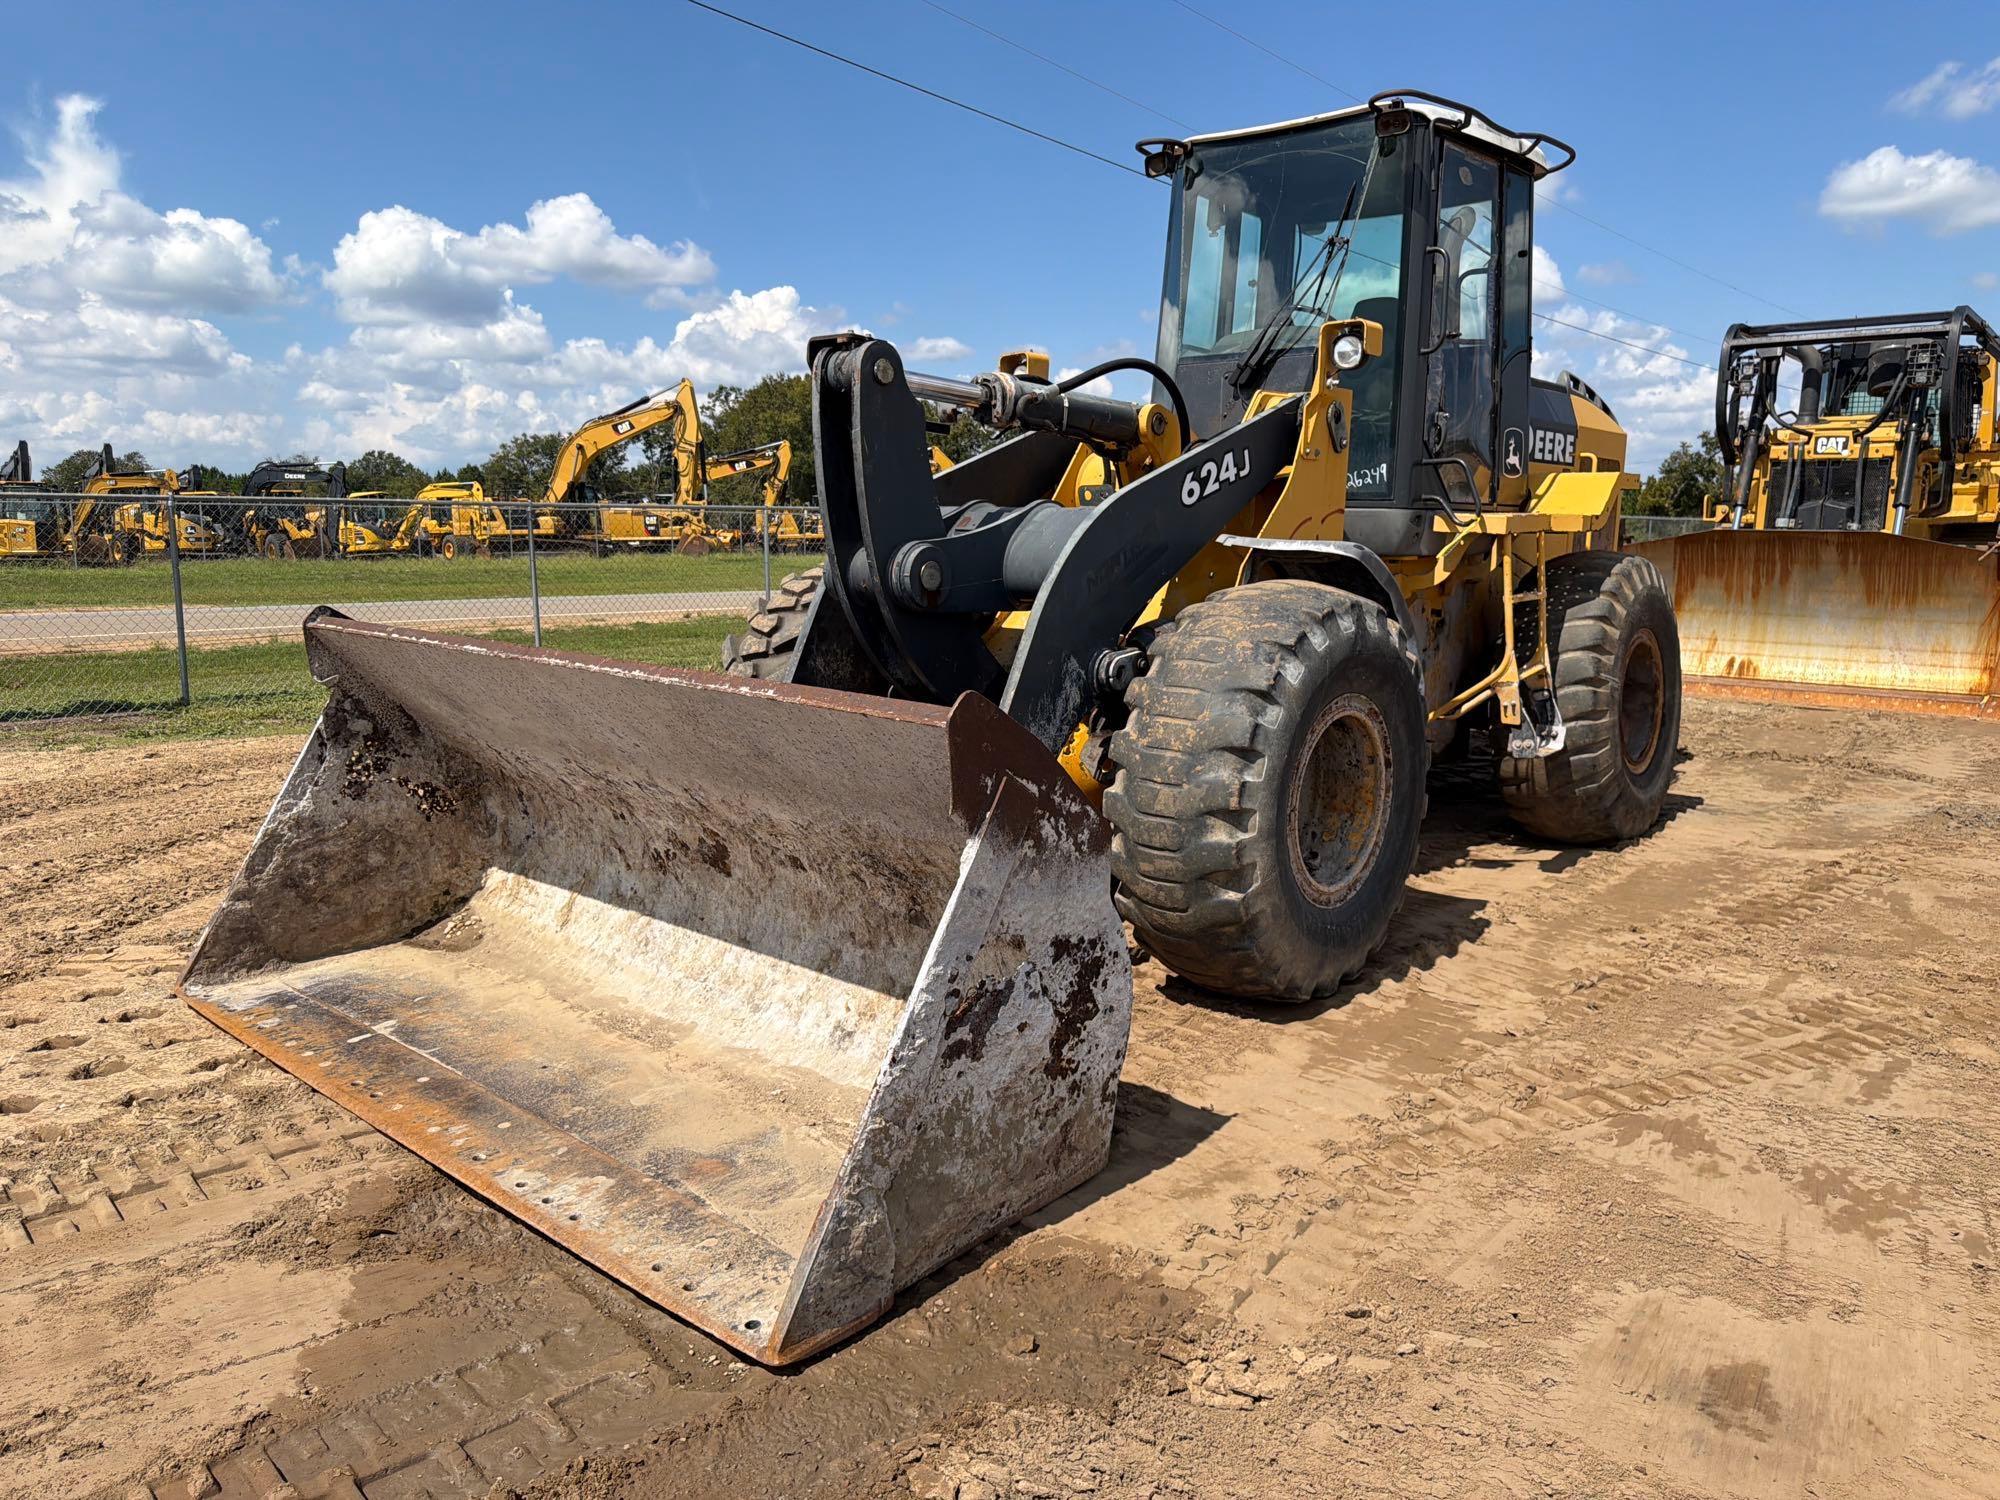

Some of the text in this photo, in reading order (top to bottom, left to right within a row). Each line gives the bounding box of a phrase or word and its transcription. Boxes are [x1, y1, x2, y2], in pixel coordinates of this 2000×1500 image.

[617, 421, 631, 434] CAT
[1816, 437, 1847, 454] CAT
[735, 460, 747, 471] CAT
[1181, 449, 1251, 506] 624J
[645, 516, 657, 525] CAT
